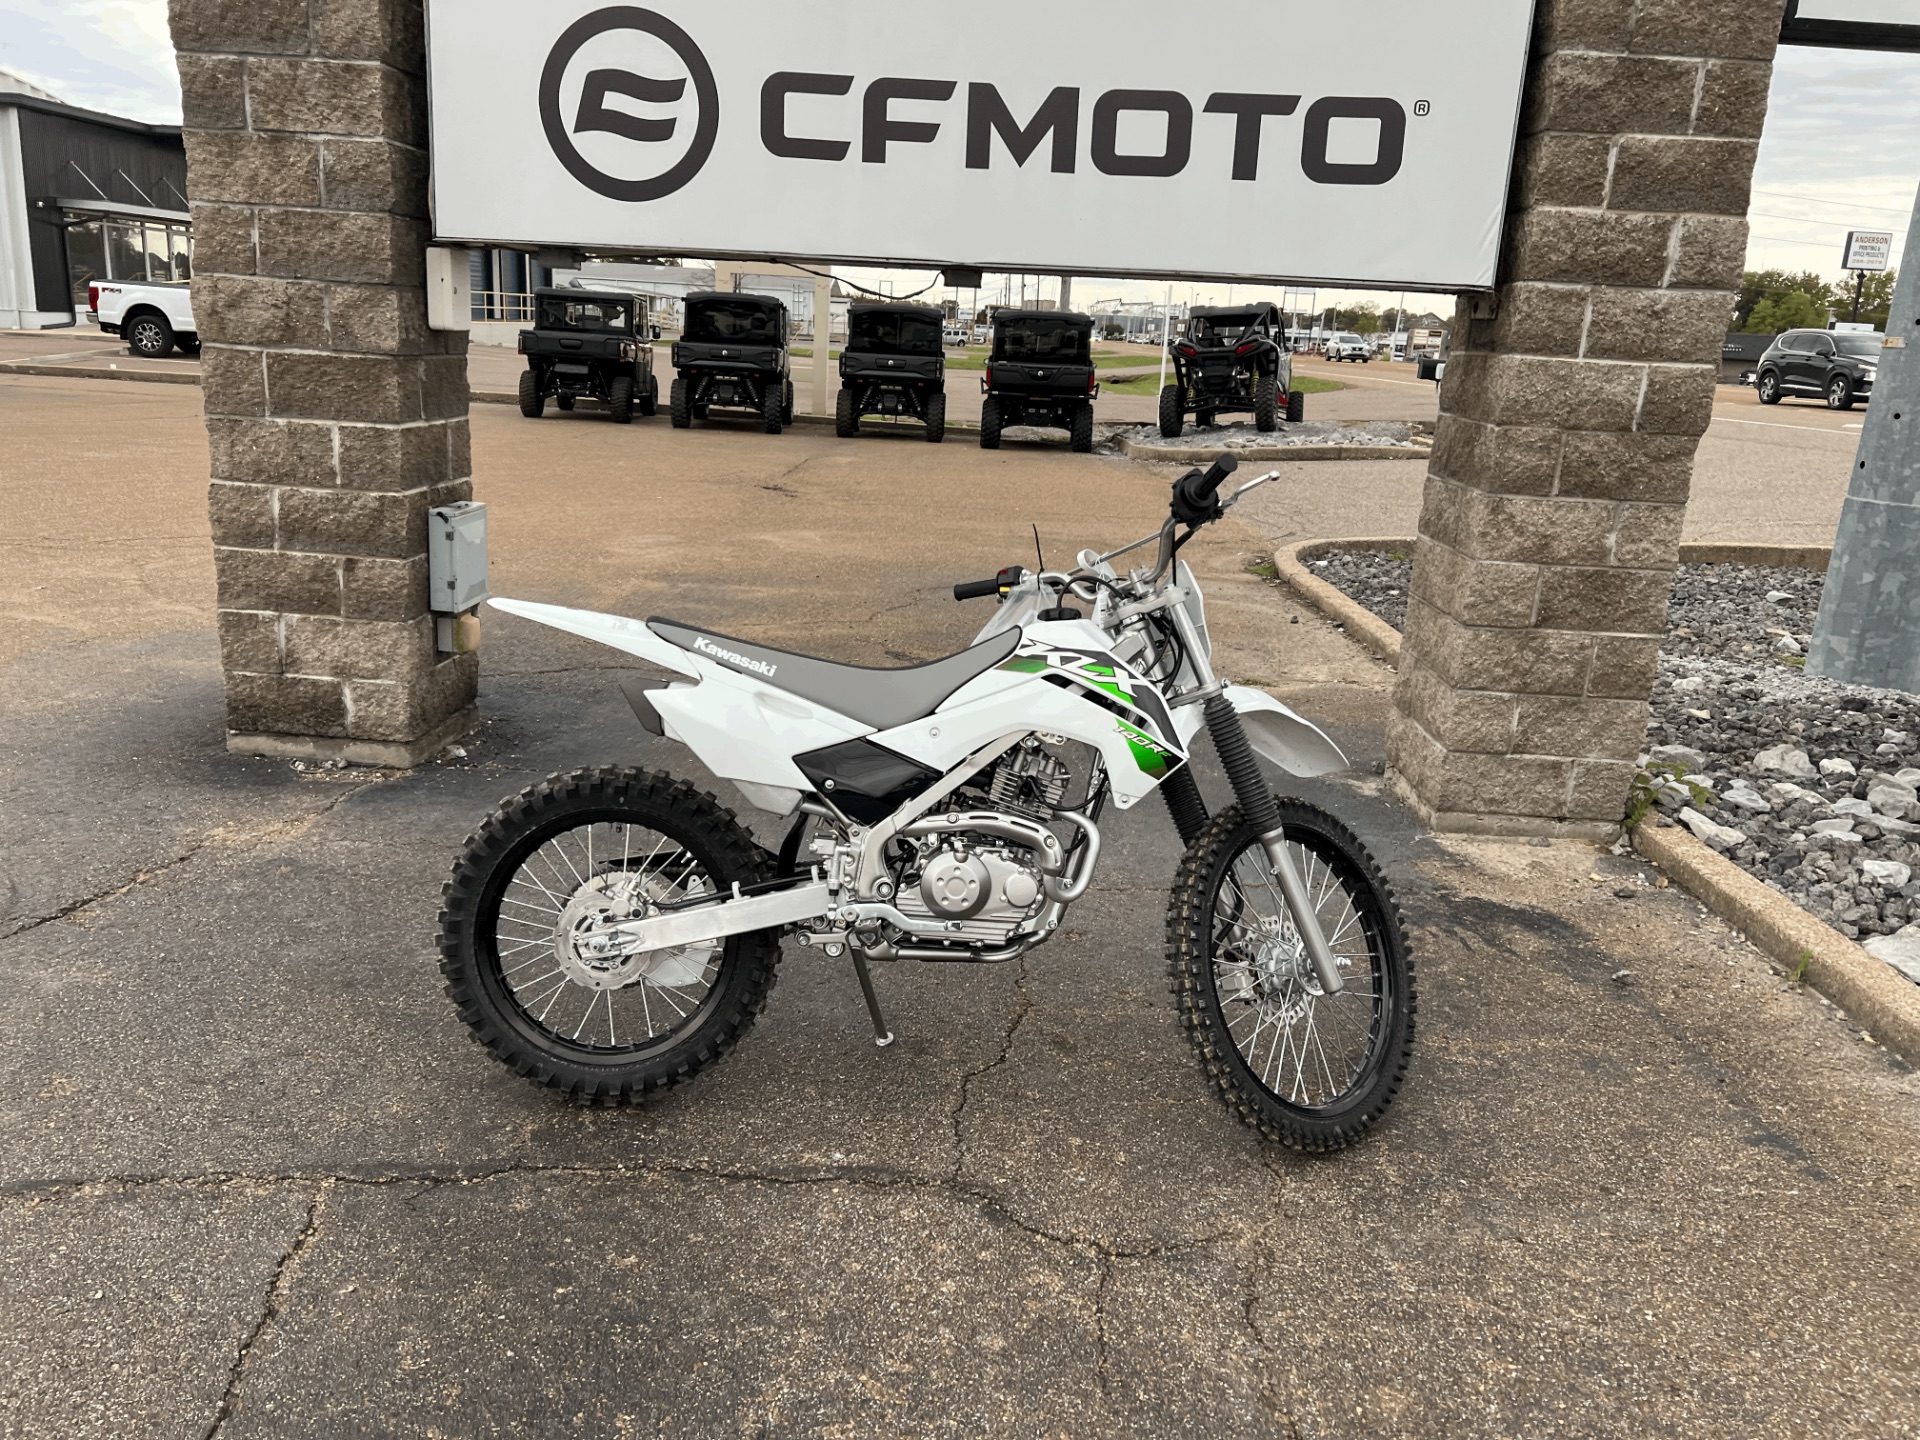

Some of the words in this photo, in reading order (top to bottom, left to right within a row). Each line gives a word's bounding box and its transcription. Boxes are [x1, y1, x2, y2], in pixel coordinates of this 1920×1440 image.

[760, 71, 1407, 186] CFMOTO
[1855, 236, 1888, 244] ANDERSON
[693, 636, 777, 677] Kawasaki
